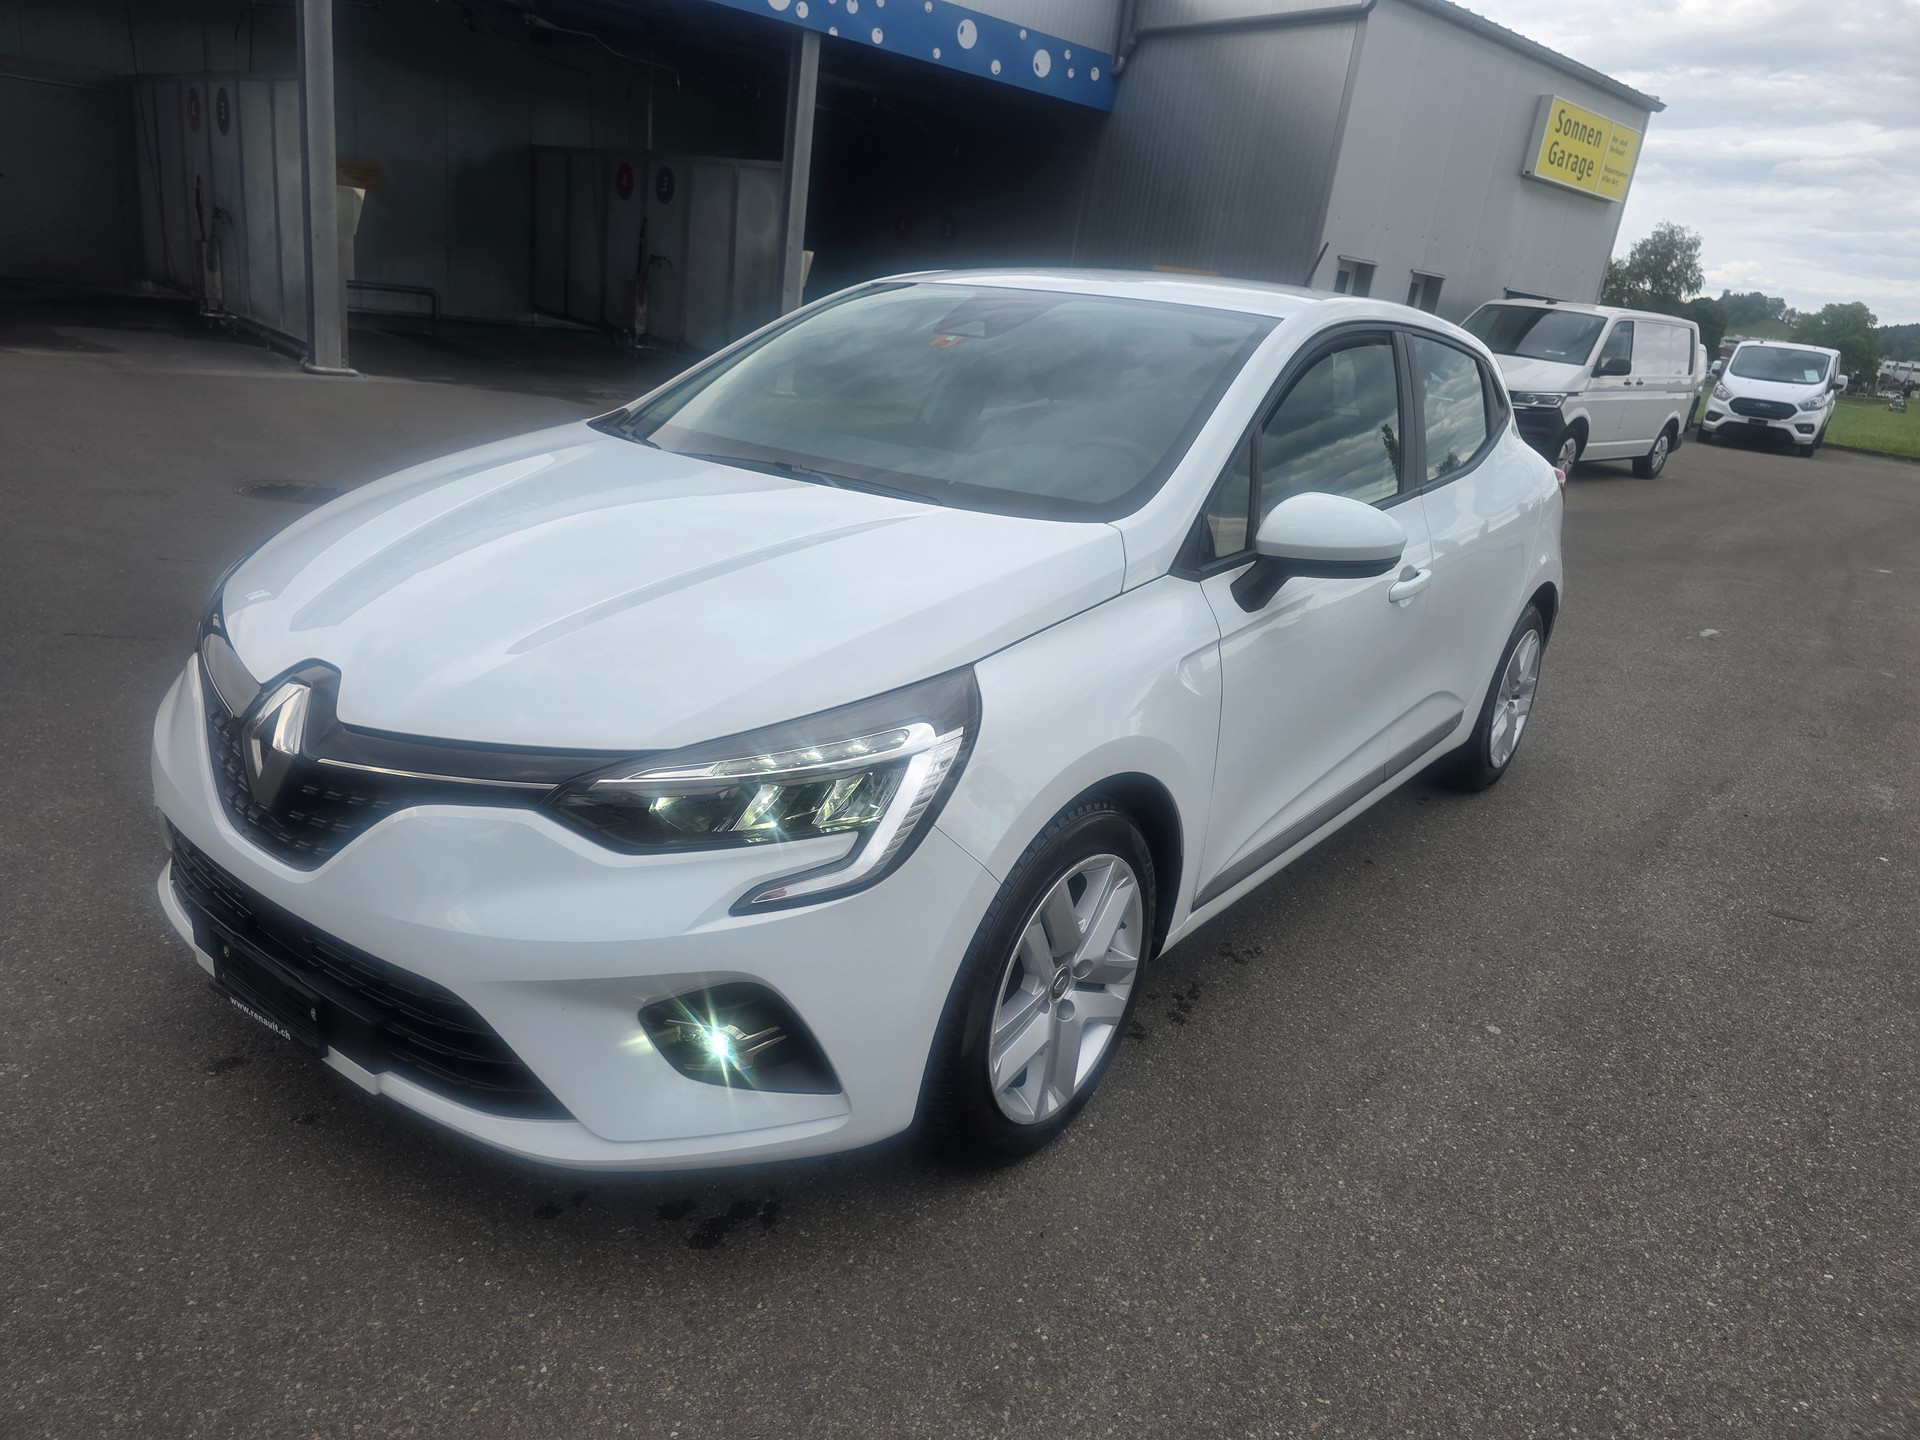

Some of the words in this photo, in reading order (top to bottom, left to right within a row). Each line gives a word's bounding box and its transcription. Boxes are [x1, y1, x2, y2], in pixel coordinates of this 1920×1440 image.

[1555, 109, 1603, 148] Sonnen
[1548, 141, 1594, 181] Garage
[661, 176, 669, 192] 3
[229, 996, 291, 1041] www.renault.ch
